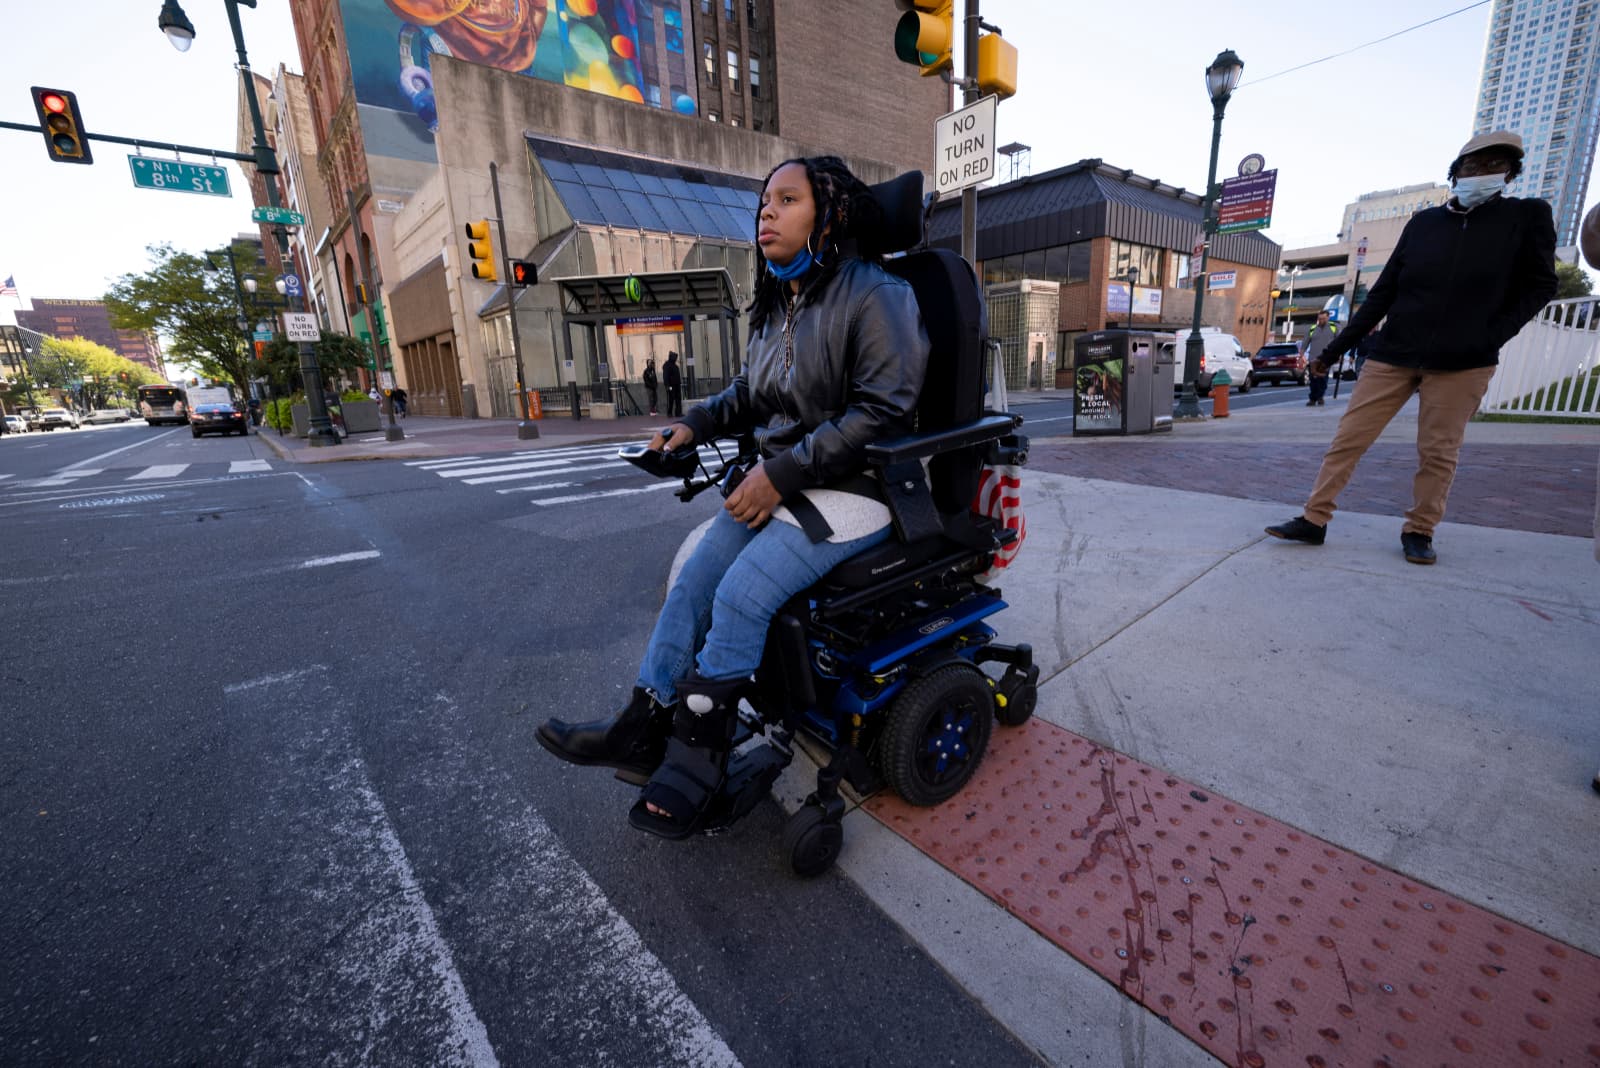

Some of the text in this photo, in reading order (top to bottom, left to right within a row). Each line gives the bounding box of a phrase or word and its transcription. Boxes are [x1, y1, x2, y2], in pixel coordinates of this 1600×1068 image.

[953, 114, 976, 136] NO
[944, 133, 985, 162] TURN
[940, 156, 989, 186] ON RED
[152, 172, 214, 193] 8th St
[290, 214, 302, 224] St
